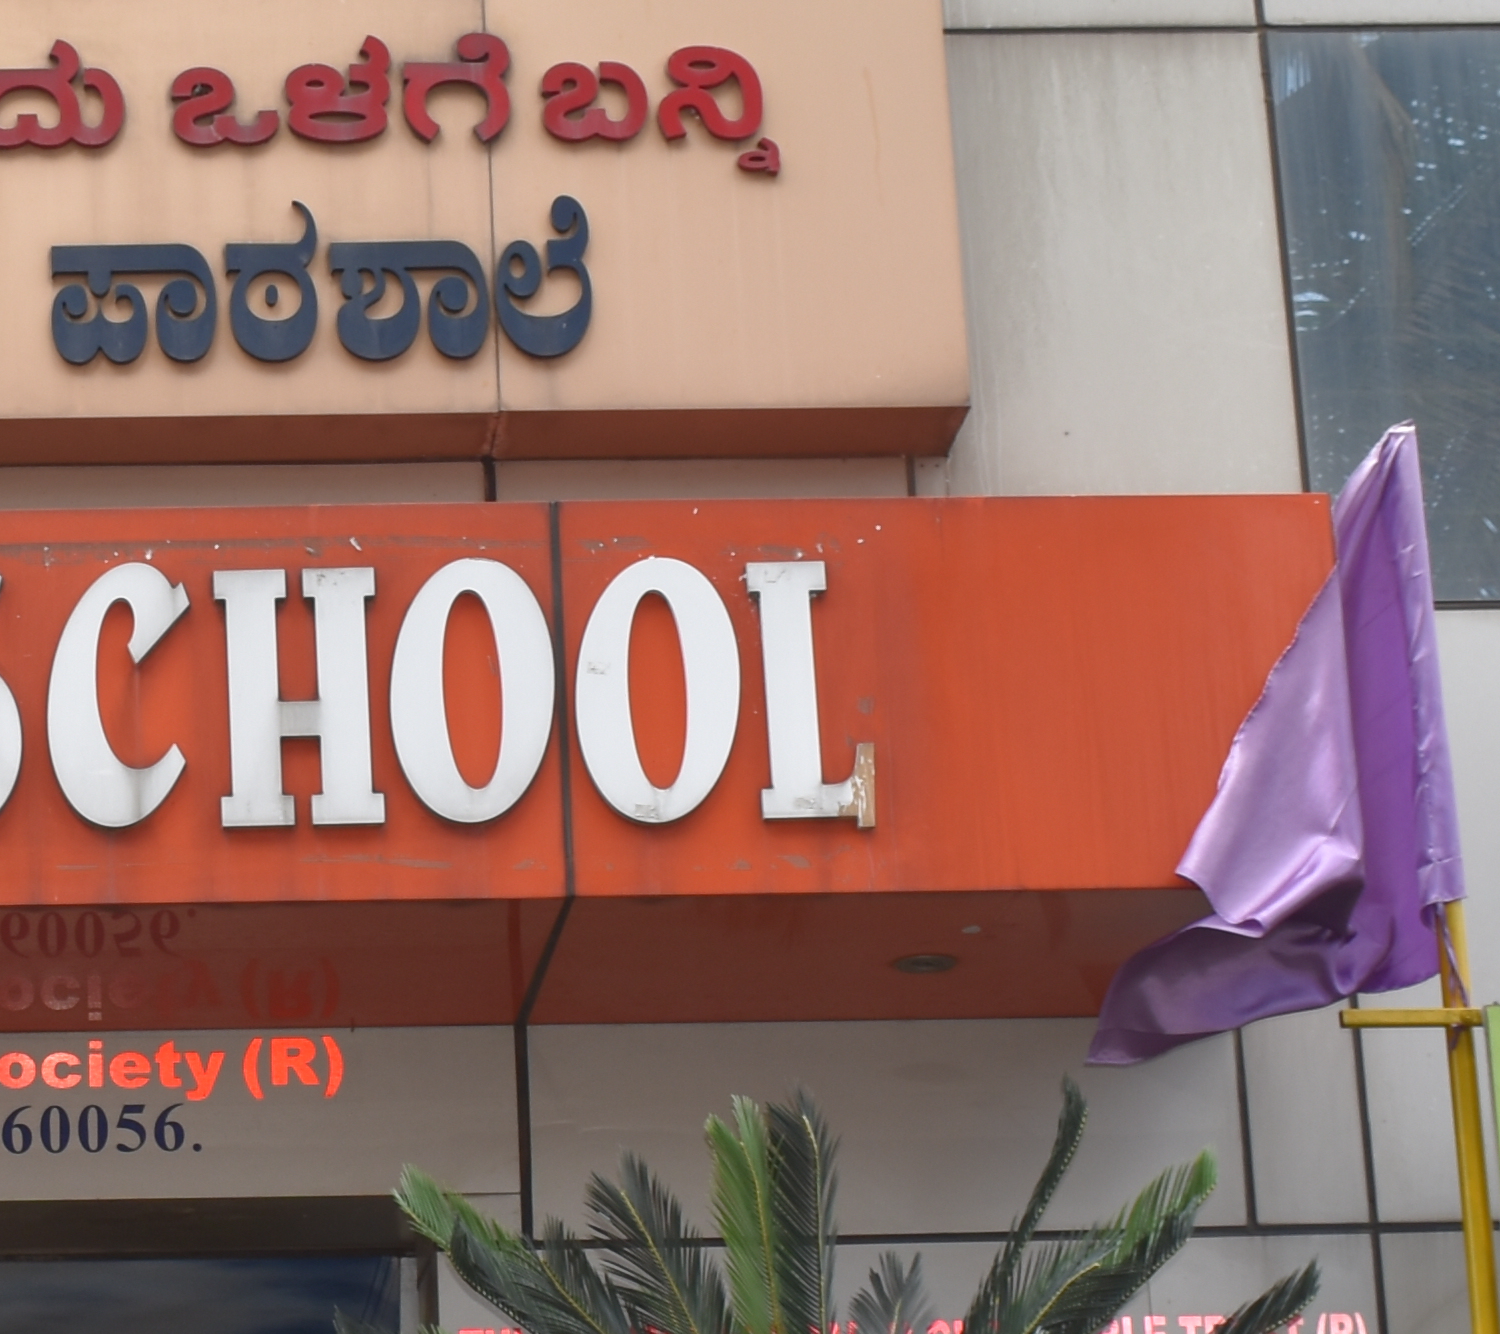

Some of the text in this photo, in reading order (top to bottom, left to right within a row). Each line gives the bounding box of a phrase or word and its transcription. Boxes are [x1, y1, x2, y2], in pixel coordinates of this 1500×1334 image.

[169, 31, 511, 148] ಒಳಗೆ
[540, 43, 780, 176] ಬನ್ನಿ
[50, 194, 594, 367] ಪಾಠಶಾಲೆ
[242, 1034, 346, 1100] (R)
